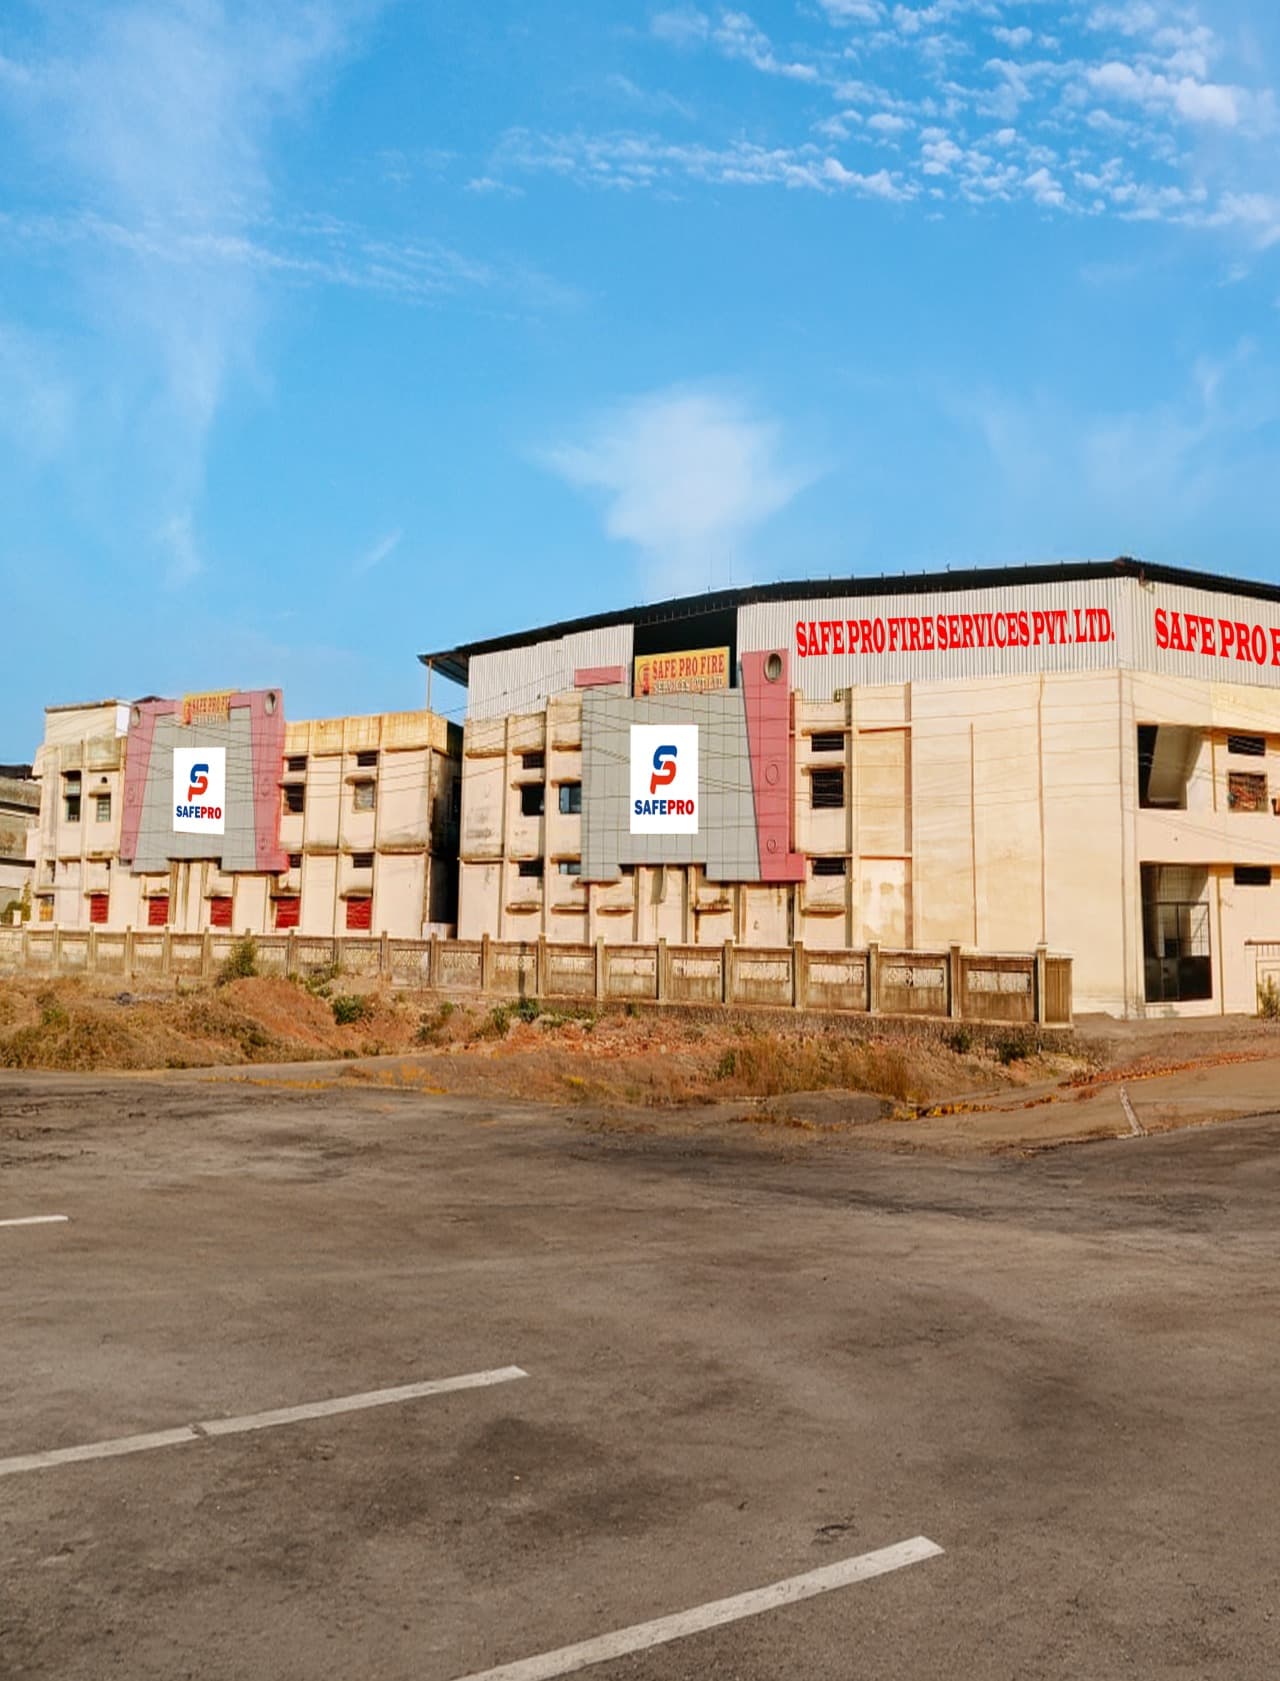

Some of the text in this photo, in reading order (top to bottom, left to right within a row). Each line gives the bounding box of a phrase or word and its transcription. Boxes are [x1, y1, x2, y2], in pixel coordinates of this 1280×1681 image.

[796, 608, 1116, 657] SAFE PRO FIRE SERVICES PVT. LTD.
[1154, 608, 1216, 656] SAFE
[1218, 619, 1267, 666] PRO
[652, 653, 725, 680] SAFE PRO FIRE
[176, 805, 222, 820] SAFEPRO
[634, 799, 695, 815] SAFEPRO
